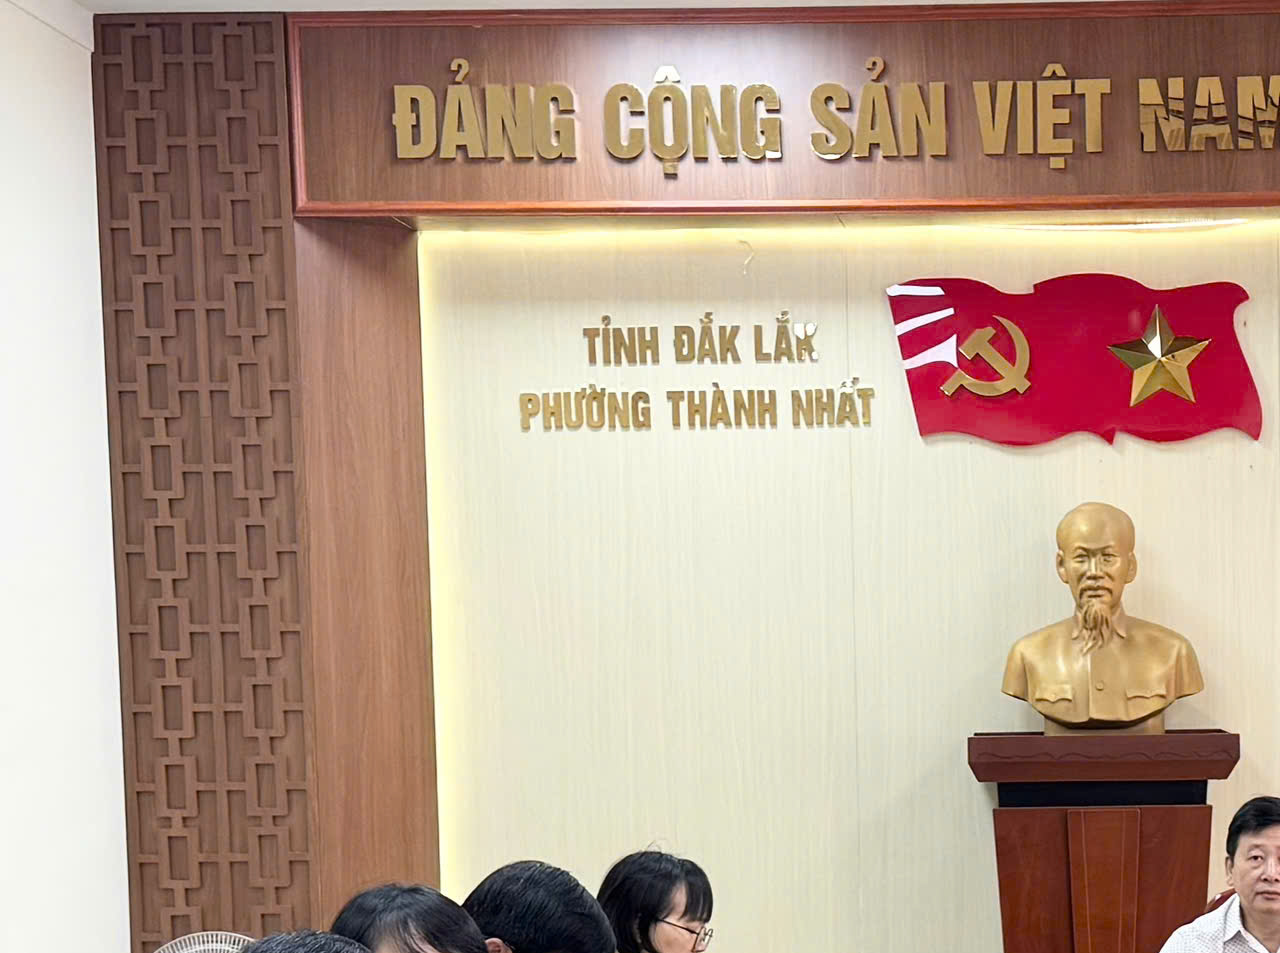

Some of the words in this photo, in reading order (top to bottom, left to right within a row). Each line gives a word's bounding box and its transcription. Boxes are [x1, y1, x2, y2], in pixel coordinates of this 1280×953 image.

[392, 58, 578, 160] ĐẢNG
[604, 65, 782, 177] CỘNG
[809, 58, 950, 160] SẢN
[972, 63, 1111, 169] VIỆT
[583, 316, 659, 366] TỈNH
[674, 312, 740, 364] ĐẮK
[754, 311, 818, 362] LẮK
[519, 384, 651, 430] PHƯỜNG
[667, 382, 777, 429] THÀNH
[791, 377, 874, 428] NHẤT
